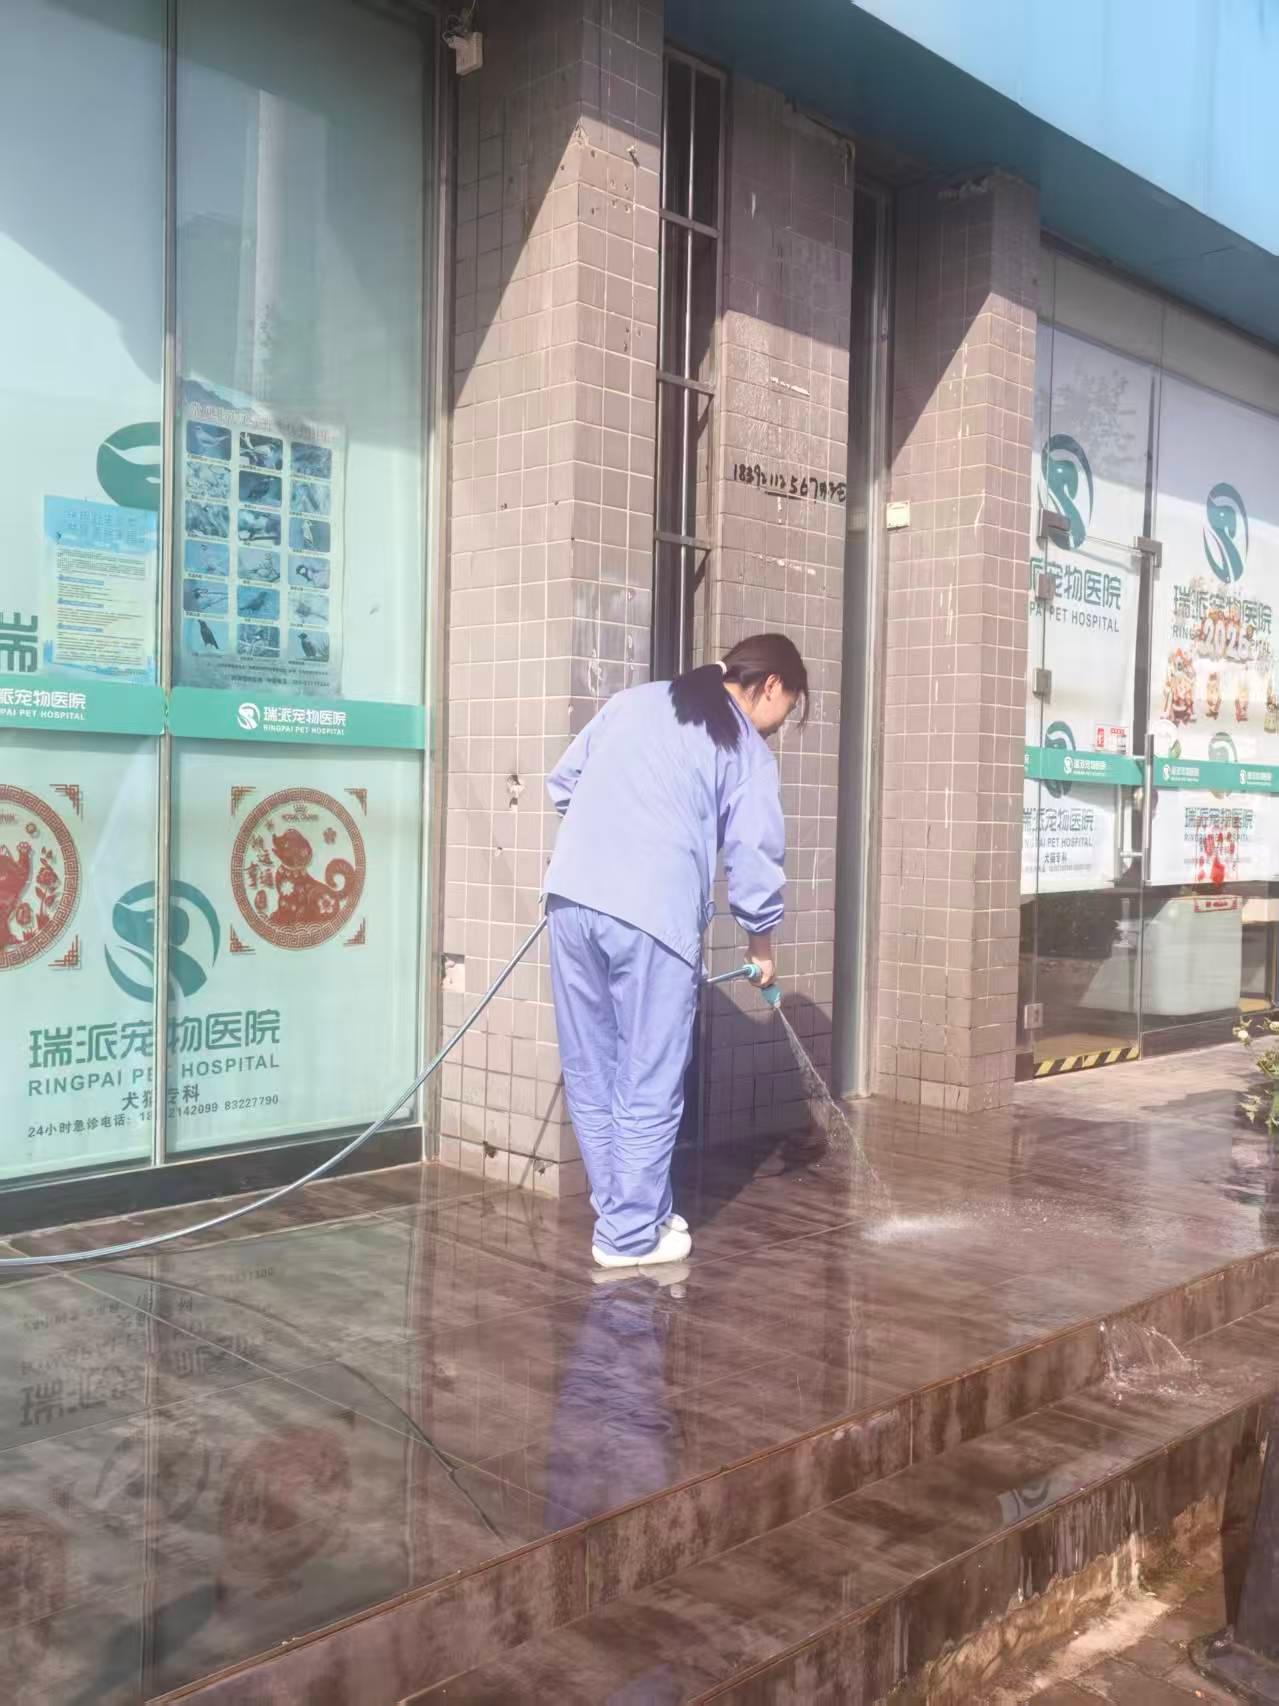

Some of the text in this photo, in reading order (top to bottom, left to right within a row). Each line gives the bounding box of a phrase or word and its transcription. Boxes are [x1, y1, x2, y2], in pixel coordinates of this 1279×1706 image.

[1072, 610, 1119, 632] HOSPITAL
[19, 710, 37, 718] PET
[41, 711, 85, 721] HOSPITAL
[263, 706, 347, 727] 瑞派宠物医院
[295, 726, 309, 734] PET
[29, 1009, 280, 1068] 瑞派宠物医院
[28, 1069, 122, 1097] RINGPAI
[181, 1054, 280, 1078] HOSPITAL
[224, 1095, 279, 1112] 83227790
